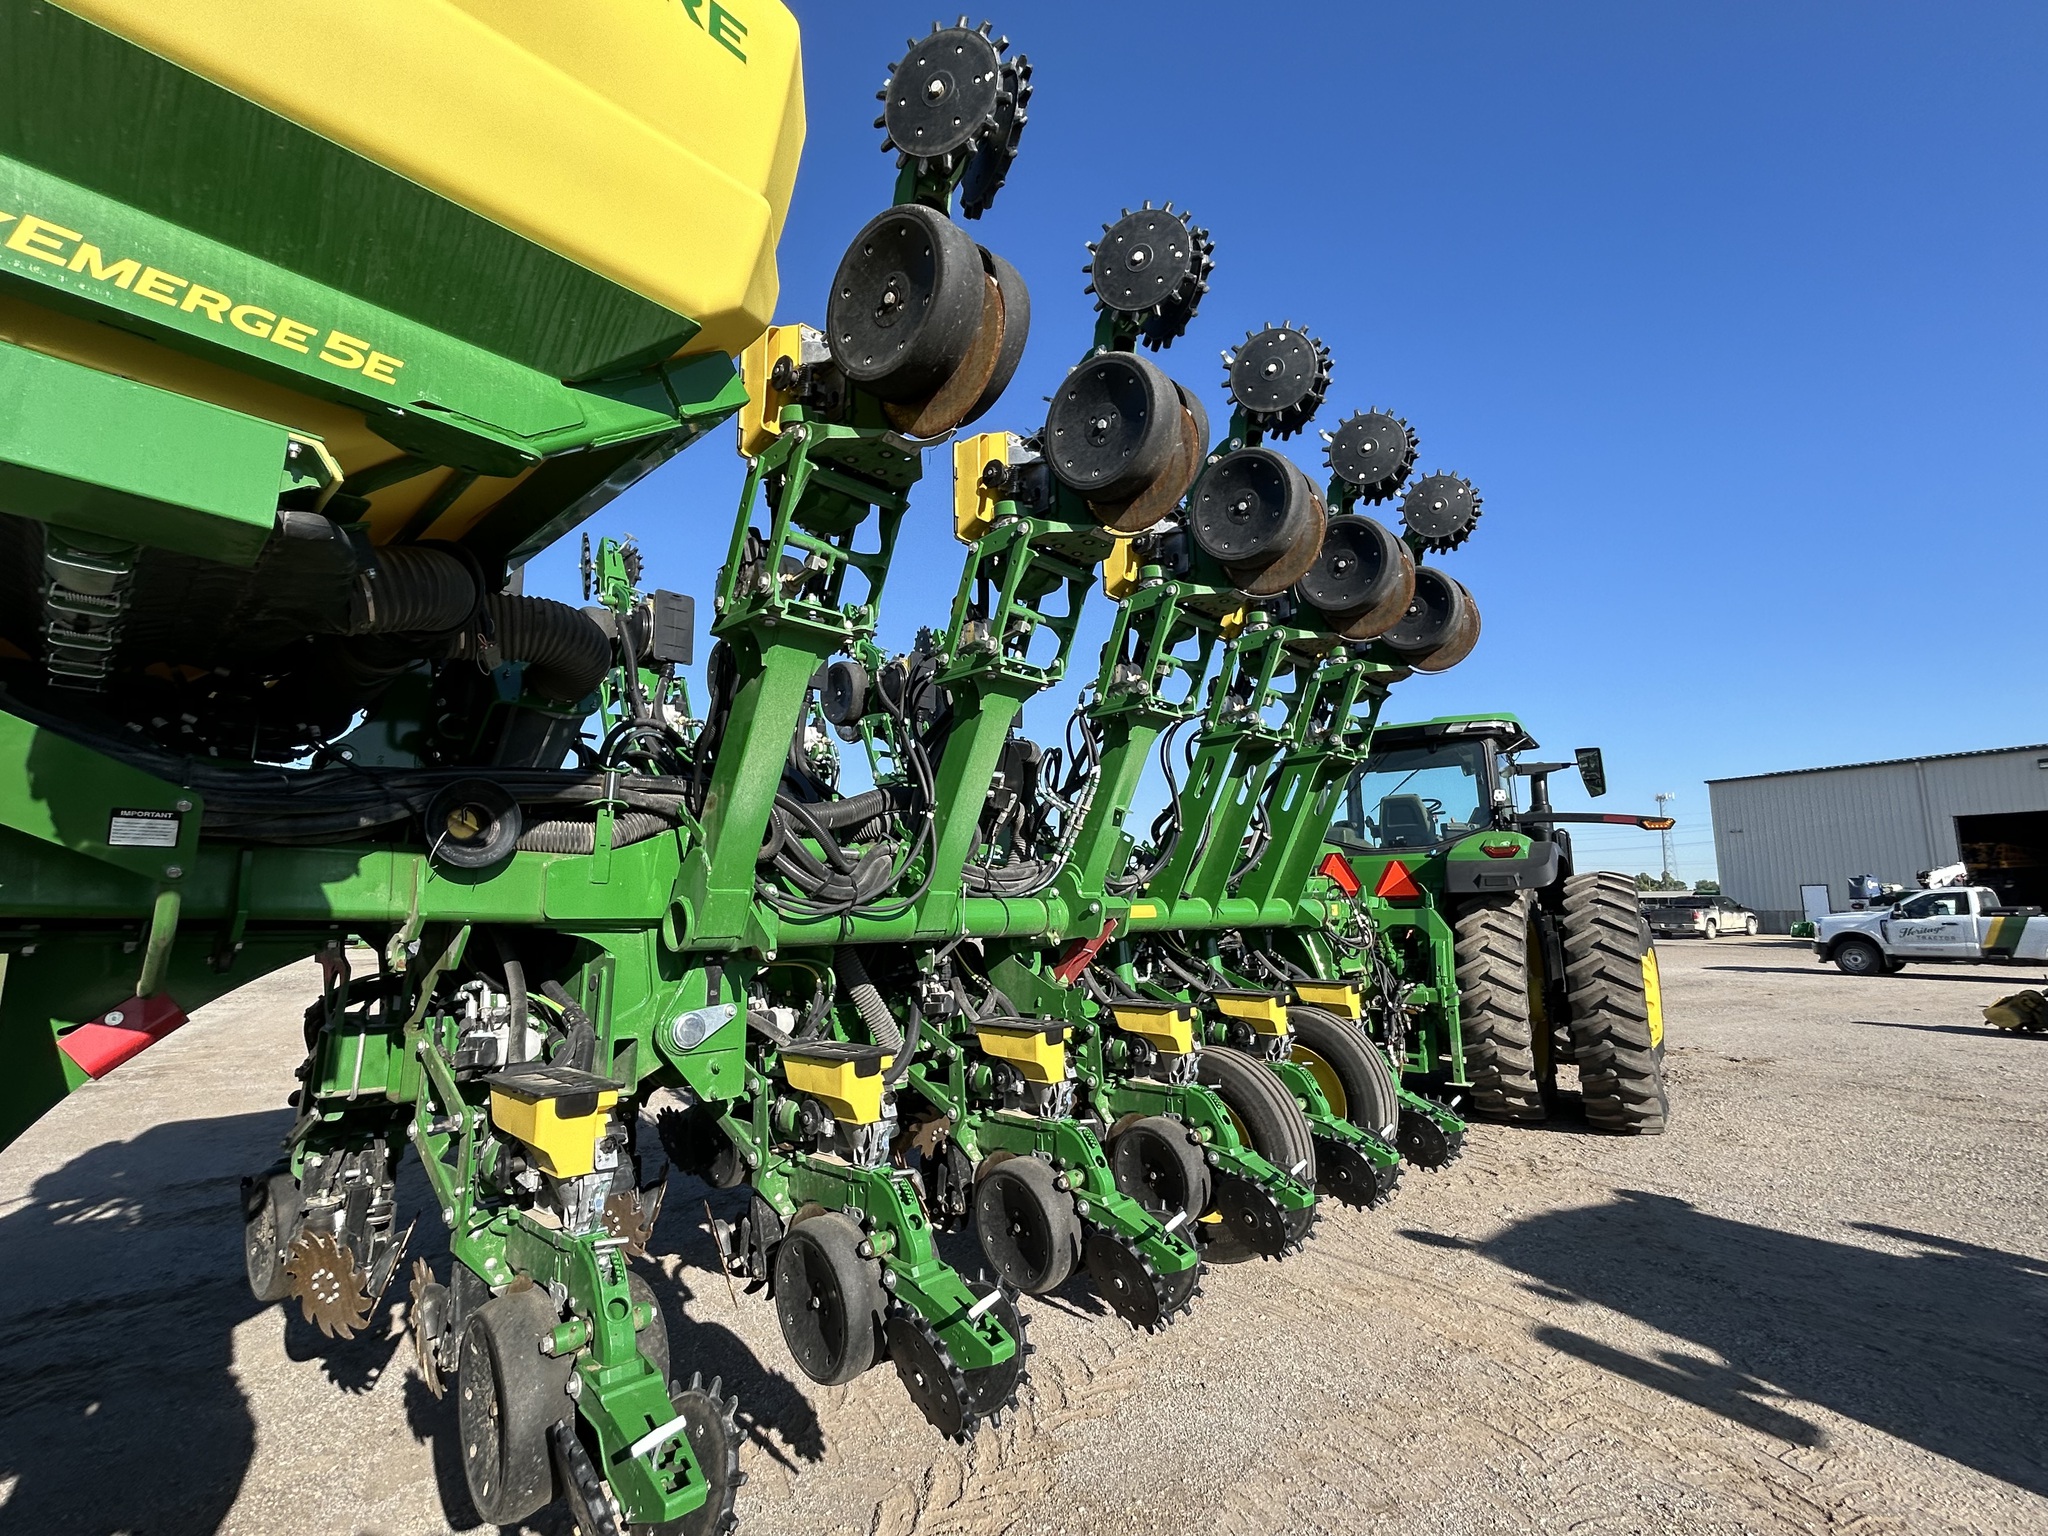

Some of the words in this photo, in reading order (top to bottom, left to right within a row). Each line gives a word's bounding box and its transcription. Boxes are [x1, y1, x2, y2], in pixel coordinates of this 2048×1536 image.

[0, 211, 318, 354] EMERGE
[319, 330, 404, 385] 5E
[120, 810, 174, 819] IMPORTANT
[1899, 926, 1946, 938] Heritage
